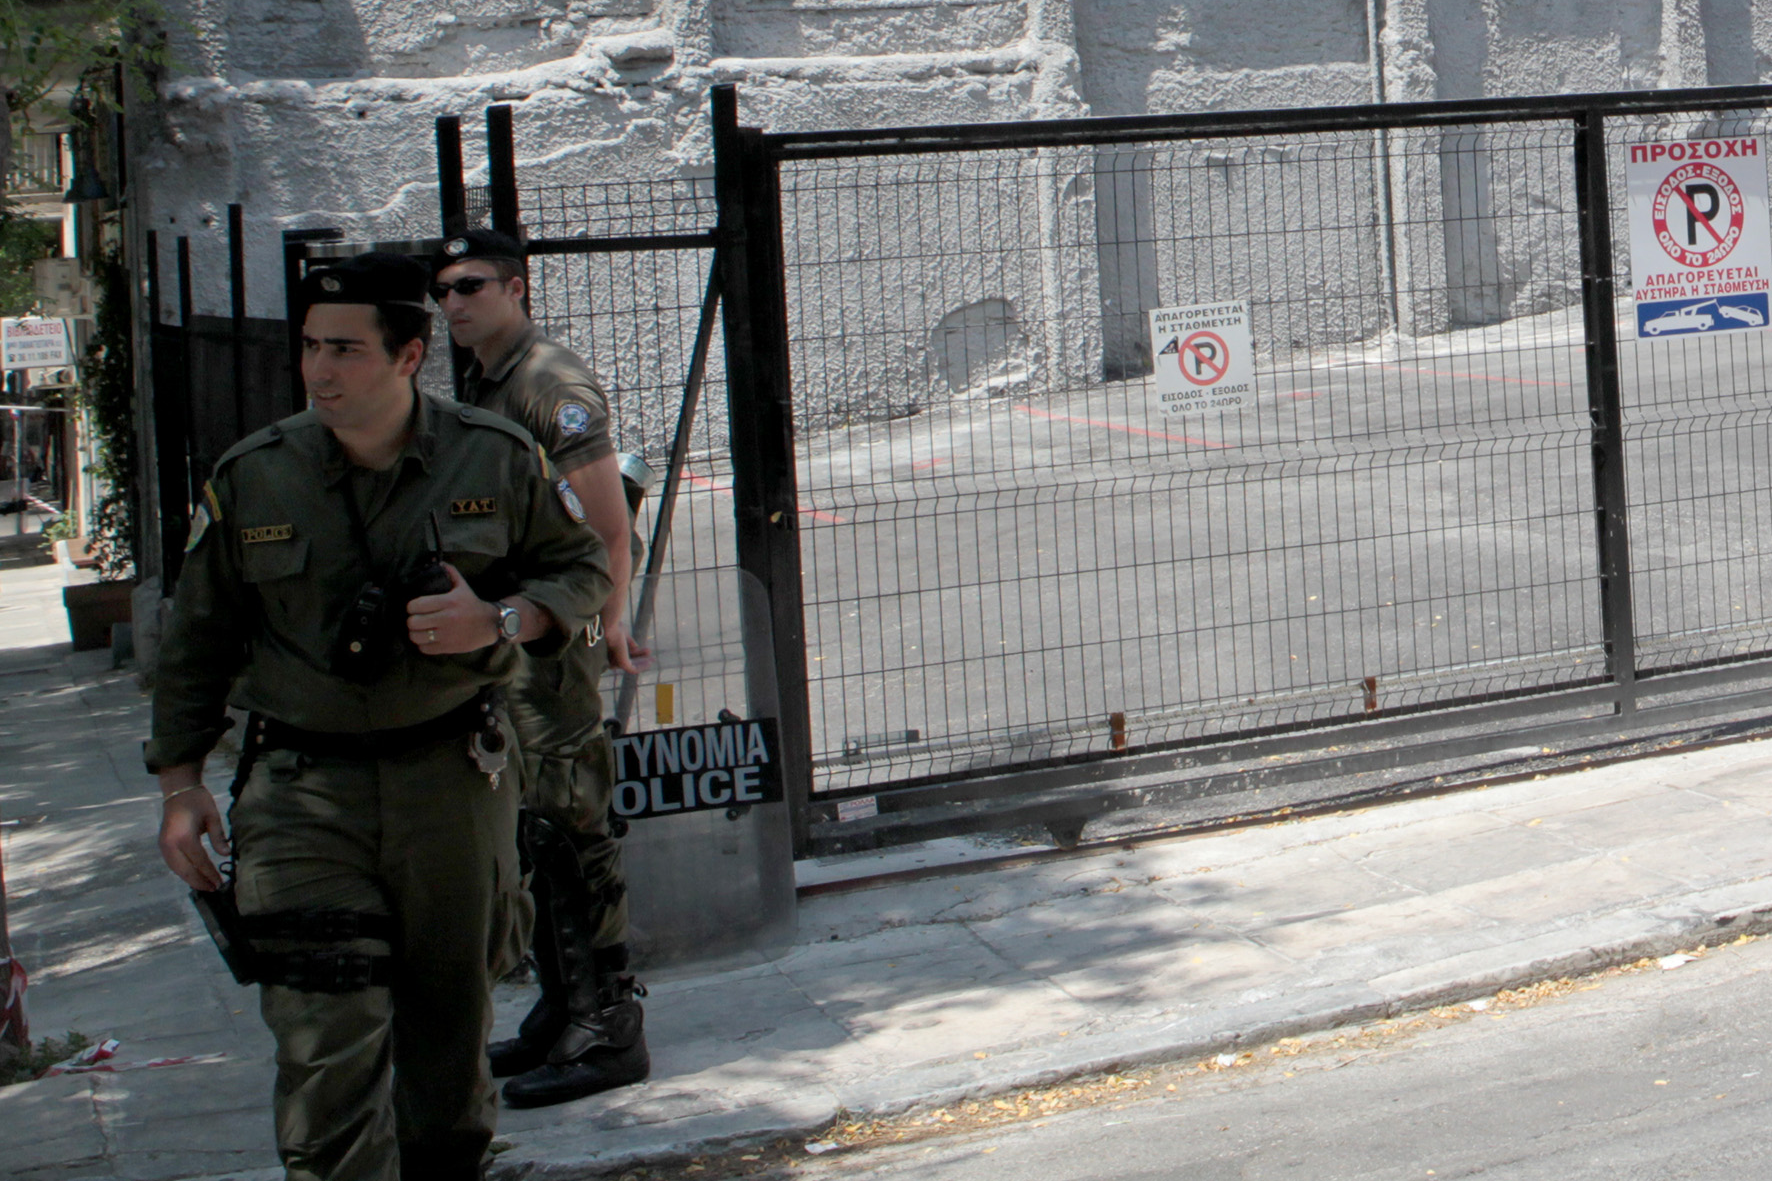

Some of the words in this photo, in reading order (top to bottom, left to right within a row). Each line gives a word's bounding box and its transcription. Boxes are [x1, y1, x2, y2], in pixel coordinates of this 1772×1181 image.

[1630, 138, 1758, 164] ΠΡΟΣΟΧΗ
[1659, 231, 1682, 258] ΟΛΟ
[1685, 252, 1703, 266] ΤΟ
[1706, 226, 1740, 264] 24ΩΡΟ
[1645, 266, 1759, 287] ΑΠΑΓΟΡΕΥΕΤΑΙ
[1635, 286, 1687, 301] ΑΥΣΤΗΡΑ
[1691, 285, 1699, 296] Η
[1703, 279, 1770, 295] ΣΤΑΘΜΕΥΣΗ
[1154, 305, 1243, 323] ΑΠΑΓΟΡΕΥΕΤΑΙ
[1158, 324, 1167, 334] Η
[1170, 316, 1242, 333] ΣΤΑΘΜΕΥΣΗ
[1161, 389, 1204, 402] ΕΙΣΟΔΟΣ
[1211, 383, 1250, 396] ΕΞΟΔΟΣ
[1171, 402, 1192, 413] ΟΛΟ
[1195, 400, 1208, 410] ΤΟ
[1210, 396, 1242, 408] 24ΩΡΟ
[247, 525, 291, 541] POLICE
